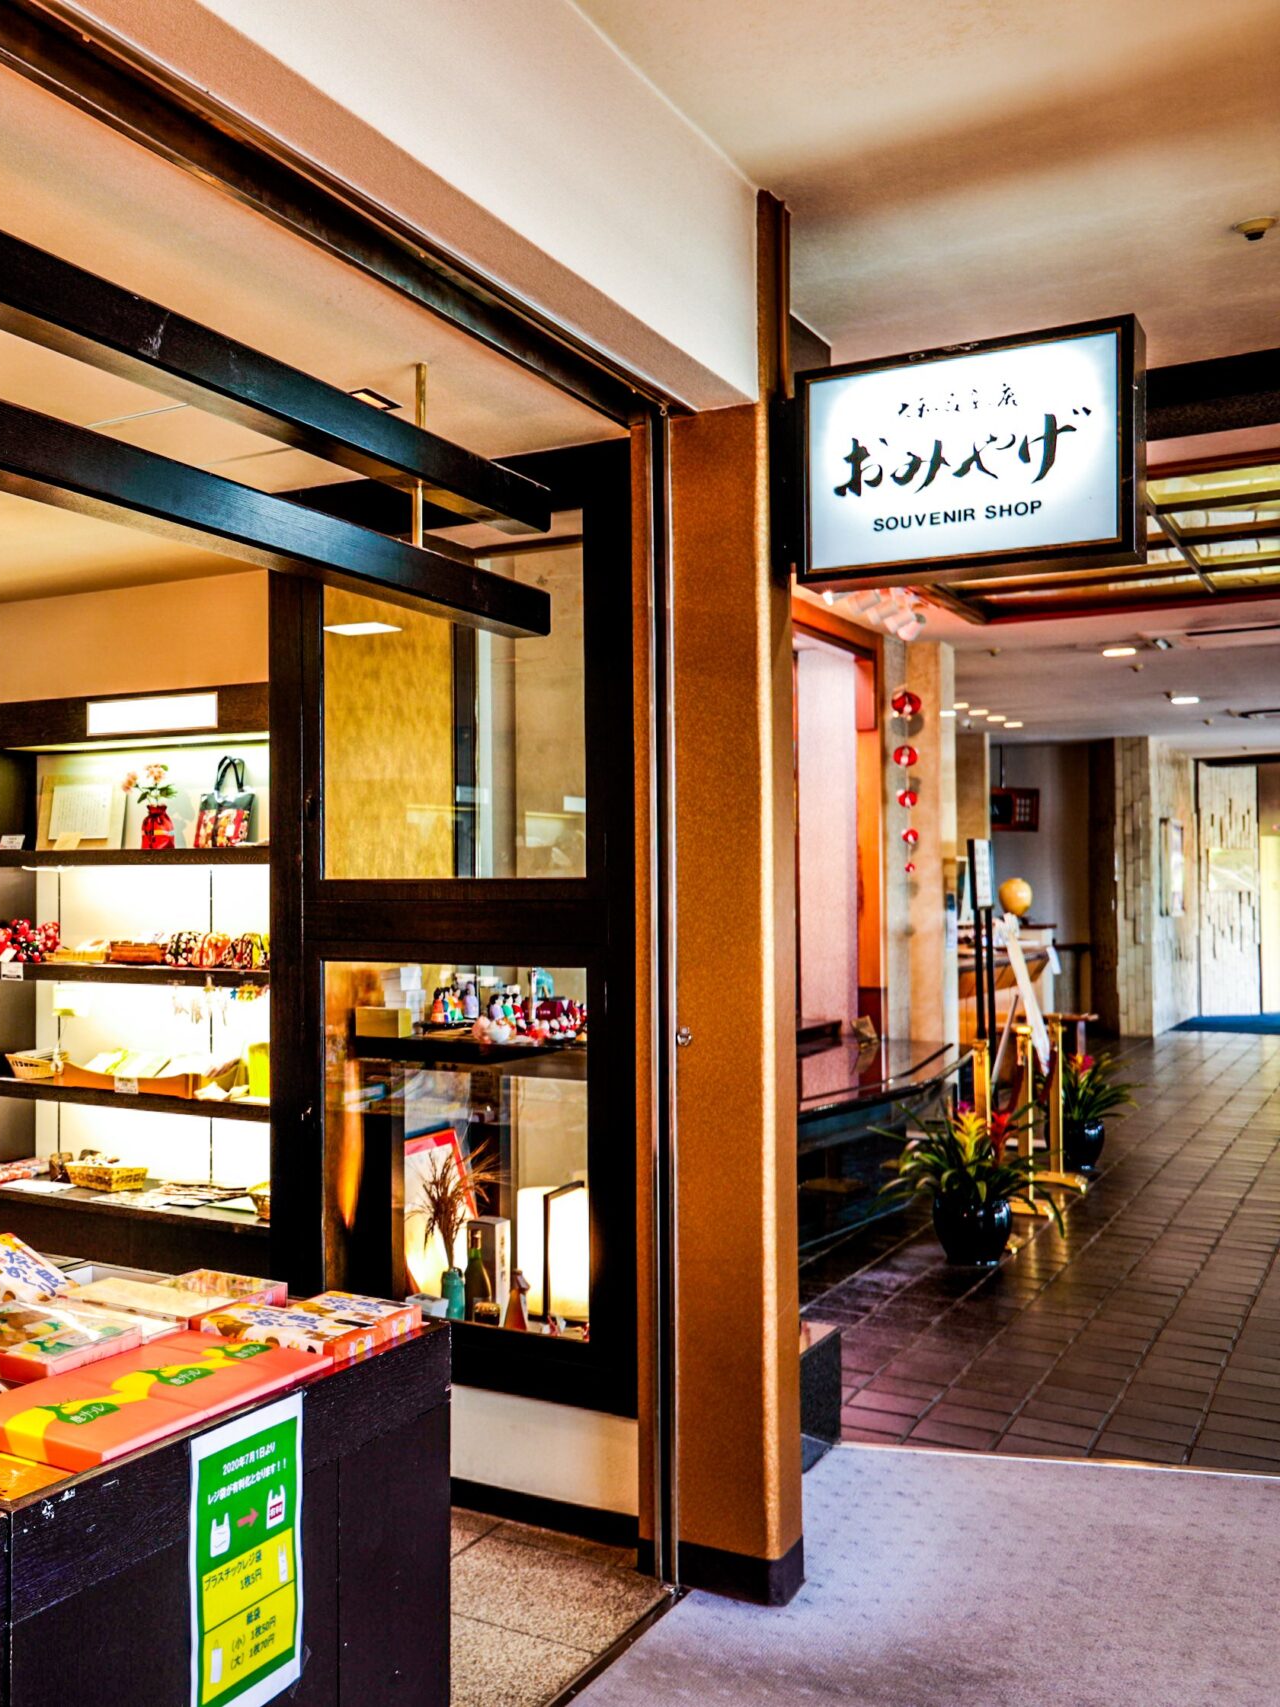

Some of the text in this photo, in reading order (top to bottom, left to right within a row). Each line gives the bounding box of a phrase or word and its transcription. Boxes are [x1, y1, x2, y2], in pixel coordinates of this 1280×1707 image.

[833, 406, 1092, 497] おみやげ
[872, 500, 1043, 532] SOUVENIR SHOP
[4, 1250, 67, 1288] 奈良
[4, 1266, 57, 1297] めぐり
[223, 1441, 276, 1476] 2020年7月1日より
[204, 1549, 262, 1592] プラスチックレジ袋
[240, 1567, 263, 1590] 1枚5円
[246, 1606, 261, 1625] 紙袋
[250, 1615, 277, 1640] 1枚50円
[248, 1632, 275, 1658] 1枚70円
